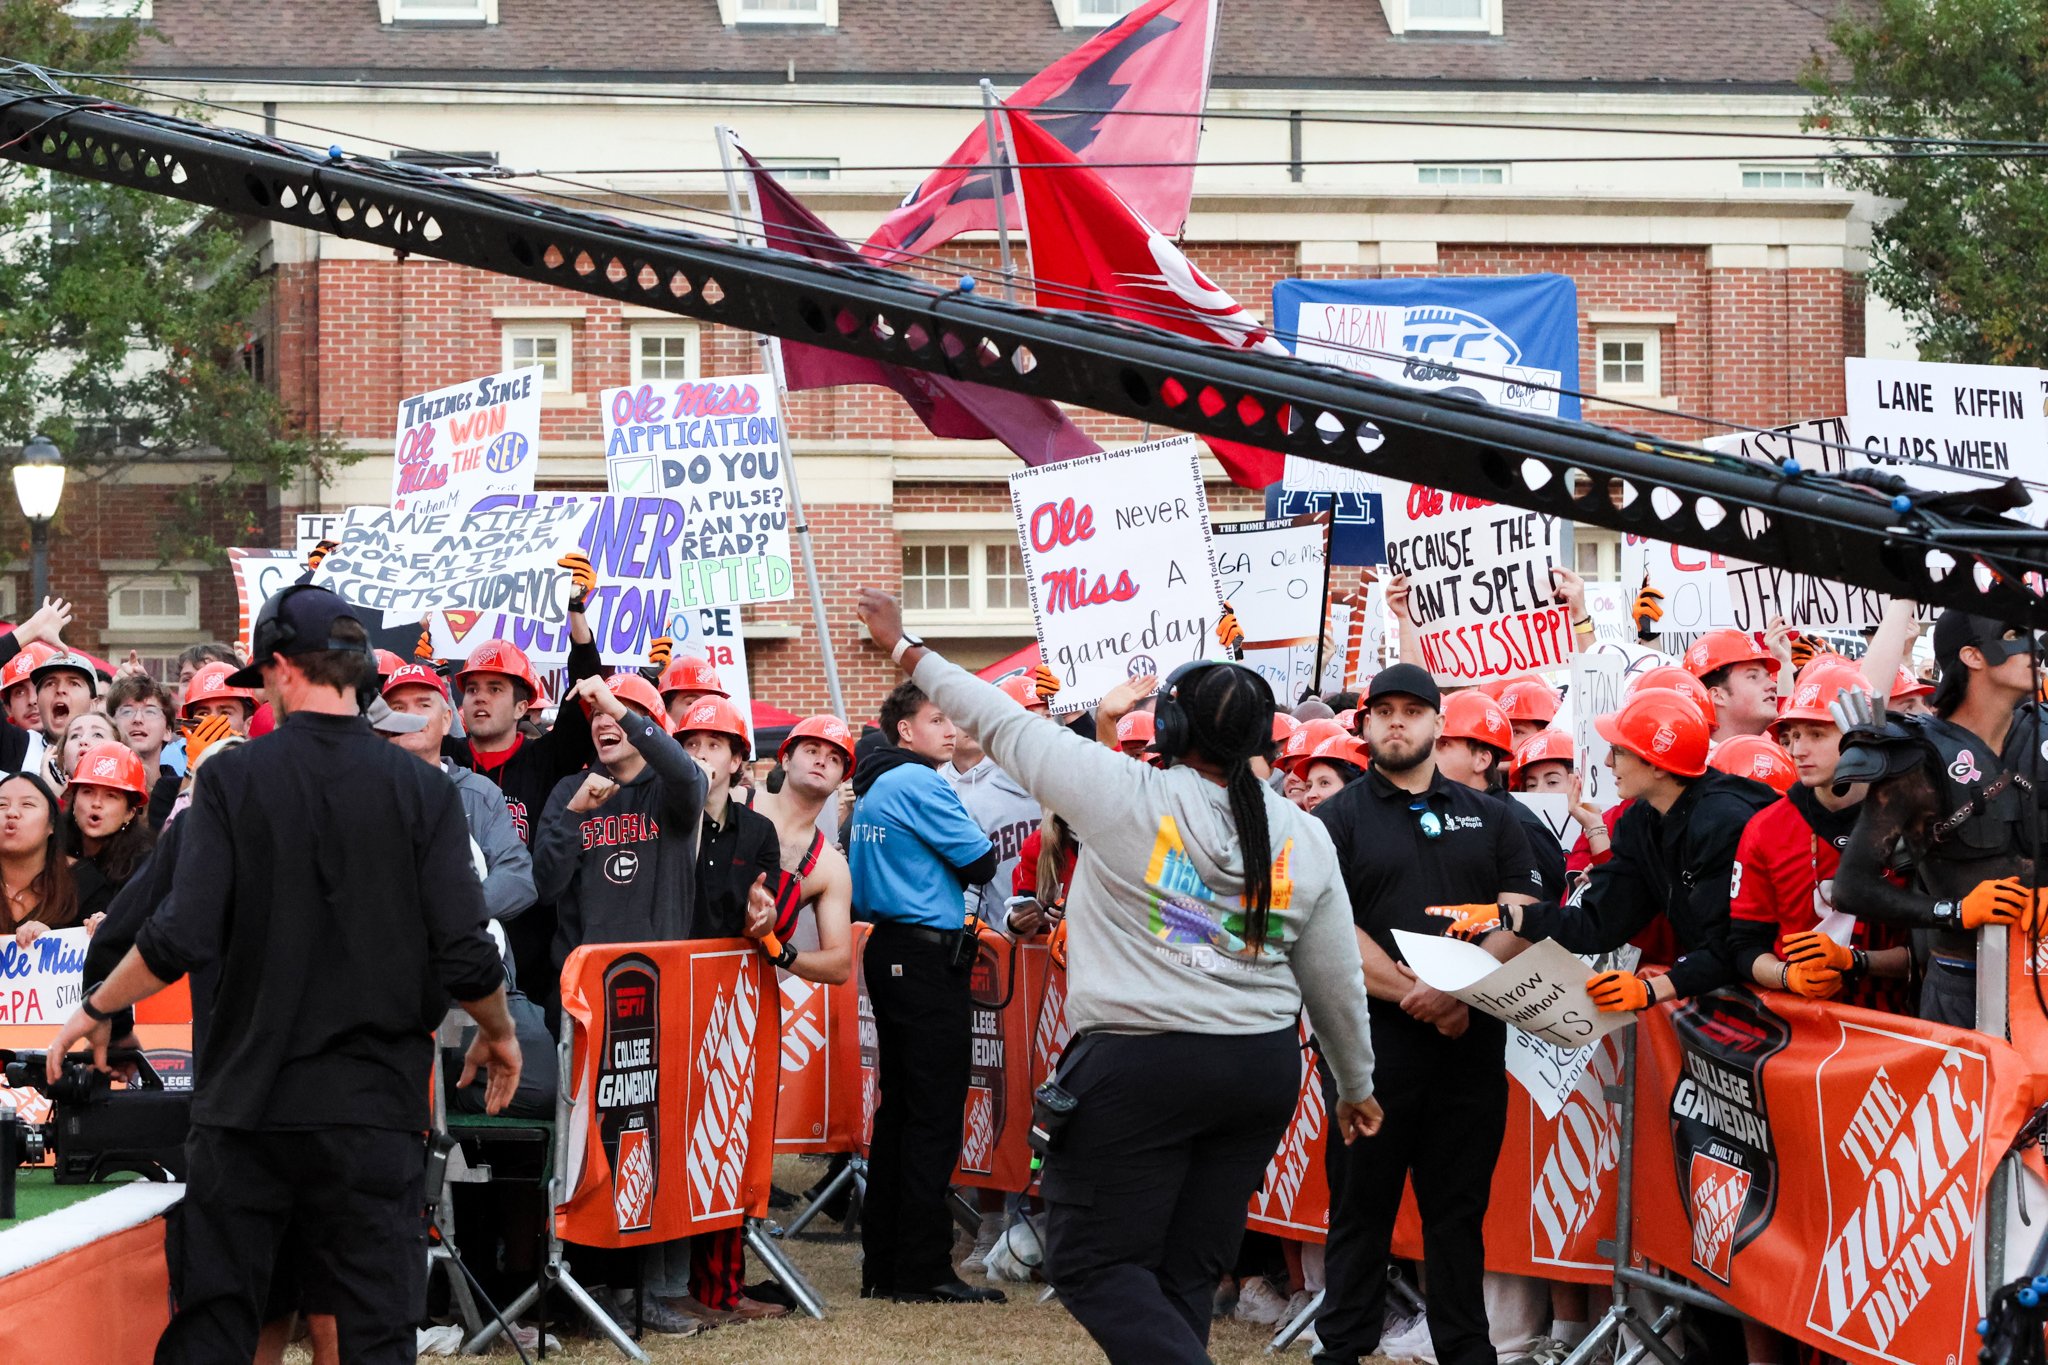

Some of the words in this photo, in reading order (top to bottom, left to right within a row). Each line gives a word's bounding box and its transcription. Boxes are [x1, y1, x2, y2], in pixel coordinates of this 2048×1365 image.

[1318, 305, 1388, 349] SABAN
[612, 384, 666, 427] Ole
[672, 382, 762, 419] Miss
[1877, 380, 1934, 413] LANE
[1954, 387, 2024, 419] KIFFIN
[398, 422, 436, 465] Ole
[449, 404, 507, 446] WON
[607, 416, 779, 457] APPLICATION
[452, 445, 484, 474] THE
[487, 432, 527, 472] SEC
[662, 454, 711, 488] DO
[719, 452, 779, 482] YOU
[1011, 467, 1039, 482] Hotty
[1041, 461, 1069, 477] Toddy
[1072, 454, 1102, 468] Hotty
[1103, 448, 1131, 463] Toddy
[1134, 442, 1160, 456] Hotty
[1160, 436, 1189, 450] Toddy
[1865, 435, 1938, 466] CLAPS
[1944, 439, 2009, 470] WHEN
[397, 459, 448, 495] Miss
[708, 487, 784, 510] PULSE?
[1407, 483, 1444, 521] Ole
[345, 508, 450, 535] LANE
[459, 503, 584, 534] KIFFIN
[432, 525, 553, 552] MORE
[740, 512, 787, 533] YOU
[1030, 497, 1096, 554] Ole
[1219, 524, 1238, 533] THE
[1240, 522, 1265, 532] HOME
[1266, 519, 1293, 530] DEPOT
[333, 545, 458, 570] WOMEN
[469, 537, 560, 564] THAN
[681, 533, 769, 560] READ?
[1271, 550, 1296, 567] Ole
[1387, 526, 1474, 578] BECAUSE
[1490, 512, 1556, 556] THEY
[325, 558, 400, 582] OLE
[406, 560, 508, 585] MISS
[1042, 566, 1140, 615] Miss
[1167, 560, 1187, 588] A
[1406, 575, 1462, 628] CANT
[1469, 555, 1569, 616] SPELL
[319, 576, 447, 609] ACCEPTS
[447, 567, 571, 624] STUDENTS
[1052, 609, 1223, 688] gameday
[387, 664, 425, 685] UGA
[1051, 702, 1079, 716] Hotty
[579, 812, 660, 850] GEORGIA
[0, 941, 32, 980] le
[1472, 972, 1544, 1012] throw
[1506, 983, 1567, 1024] without
[614, 1037, 651, 1070] COLLEGE
[696, 982, 728, 1086] THE
[597, 1069, 658, 1108] GAMEDAY
[687, 954, 760, 1215] HOME
[1688, 1050, 1752, 1109] COLLEGE
[1673, 1078, 1768, 1154] GAMEDAY
[1839, 1065, 1907, 1181] THE
[1709, 1142, 1732, 1163] BUILT
[1732, 1150, 1743, 1166] BY
[1693, 1172, 1718, 1211] THE
[1822, 1047, 1984, 1333] HOME
[1692, 1169, 1749, 1260] HOME
[1706, 1211, 1736, 1269] DEPOT
[1861, 1174, 1975, 1353] DEPOT
